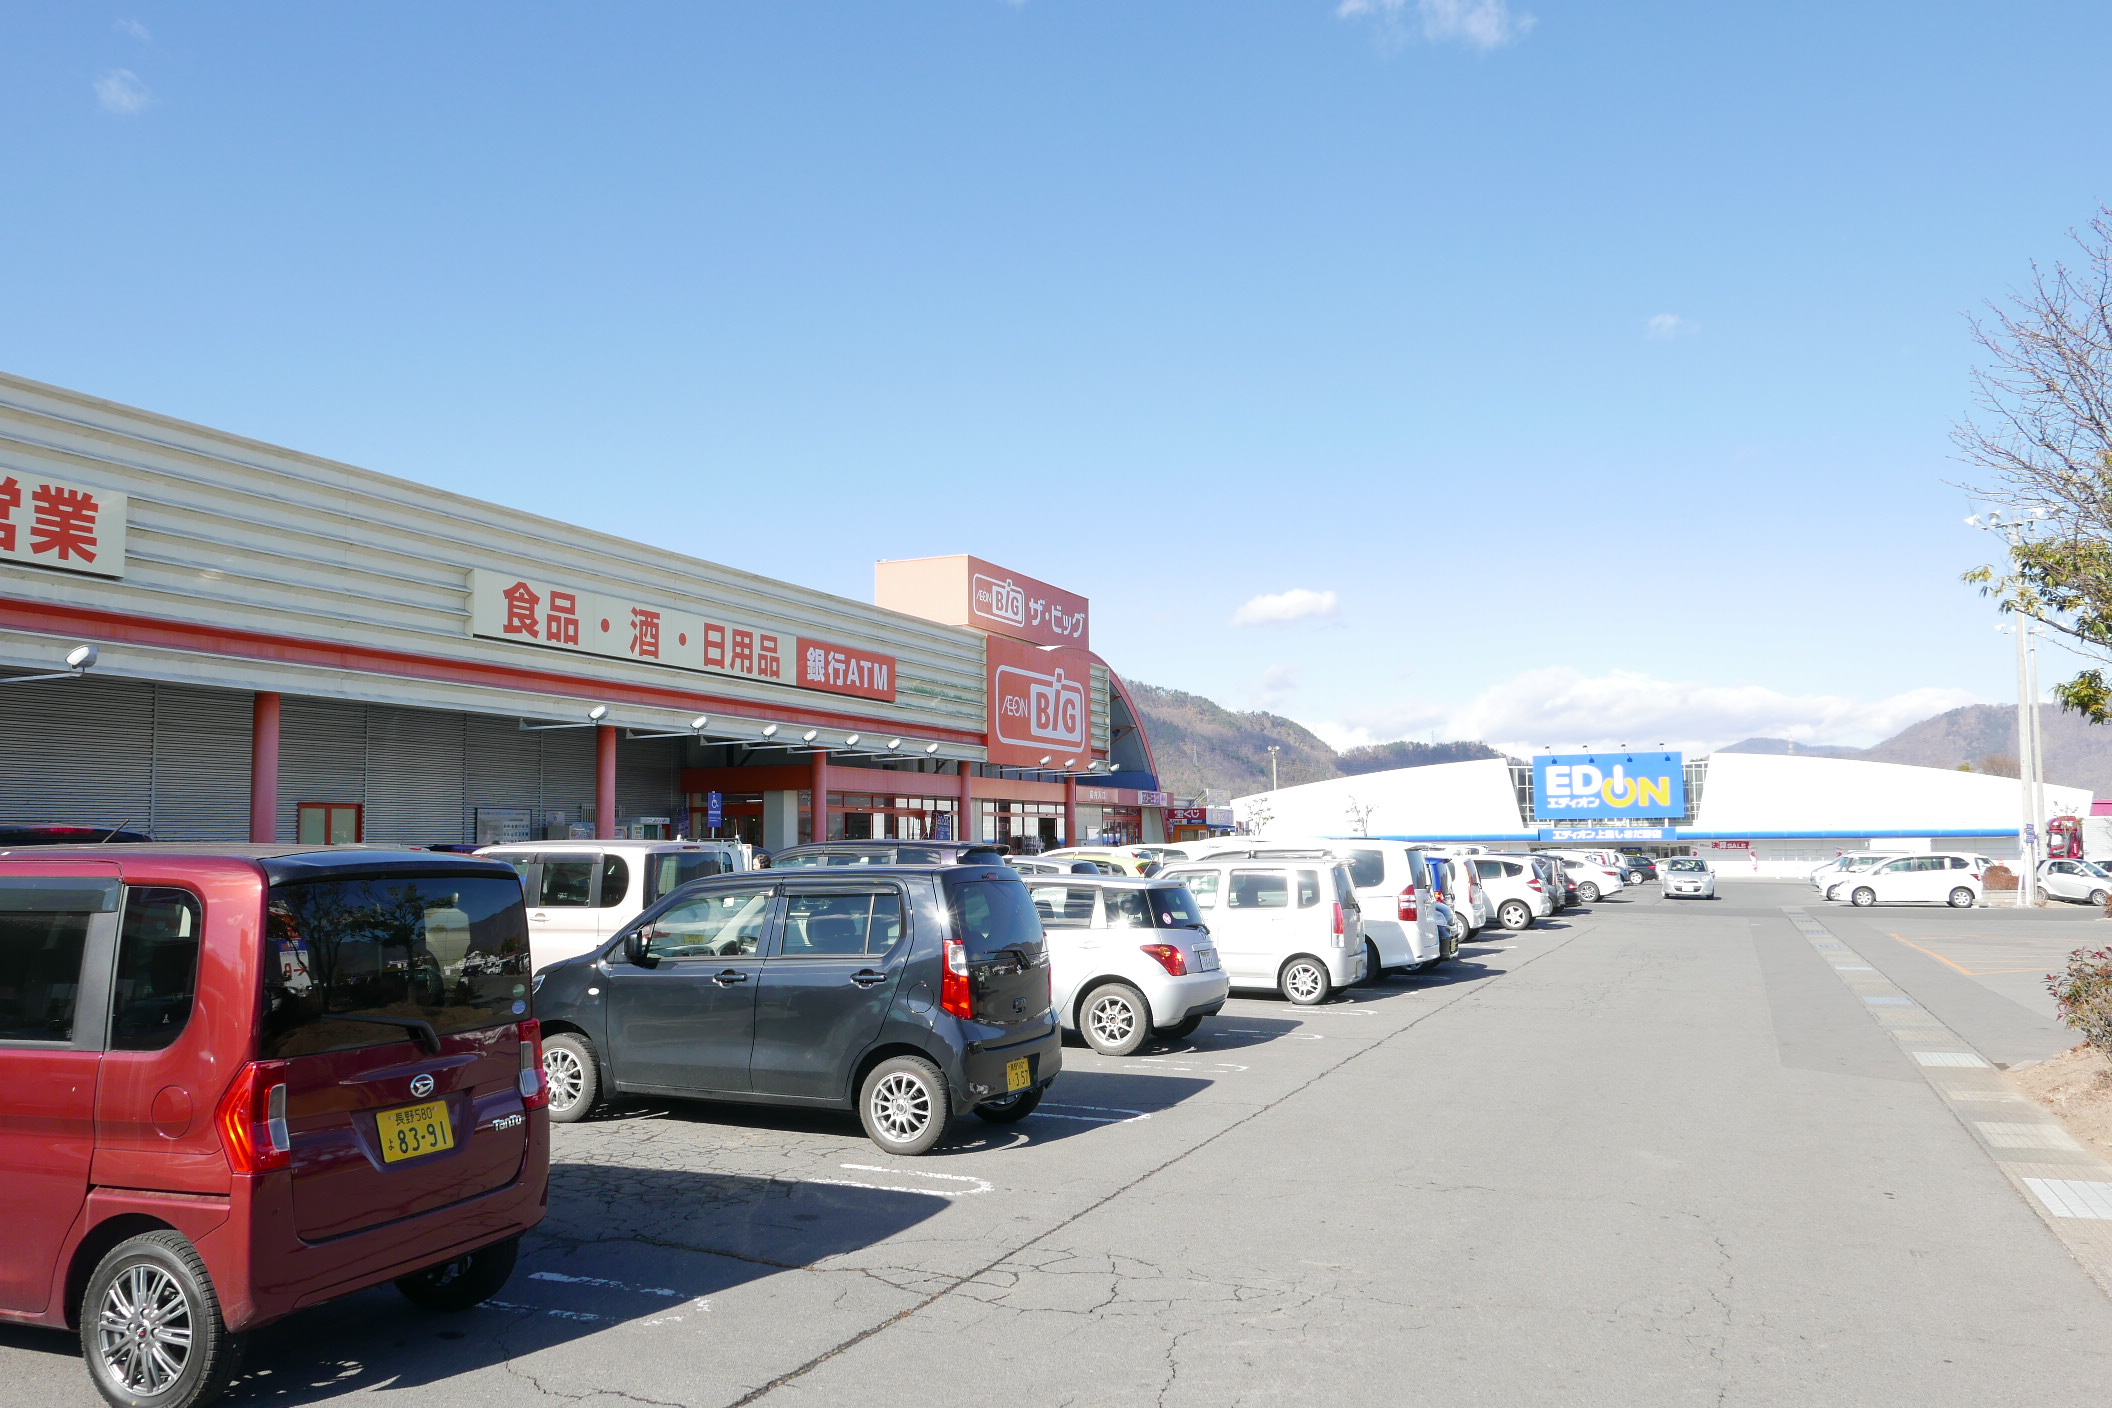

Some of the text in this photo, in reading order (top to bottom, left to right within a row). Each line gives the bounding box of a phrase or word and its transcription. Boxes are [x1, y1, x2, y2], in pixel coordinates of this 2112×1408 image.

[1029, 598, 1085, 638] ザ・ビッグ
[1547, 797, 1600, 808] エディオン
[397, 1120, 447, 1154] 83-91
